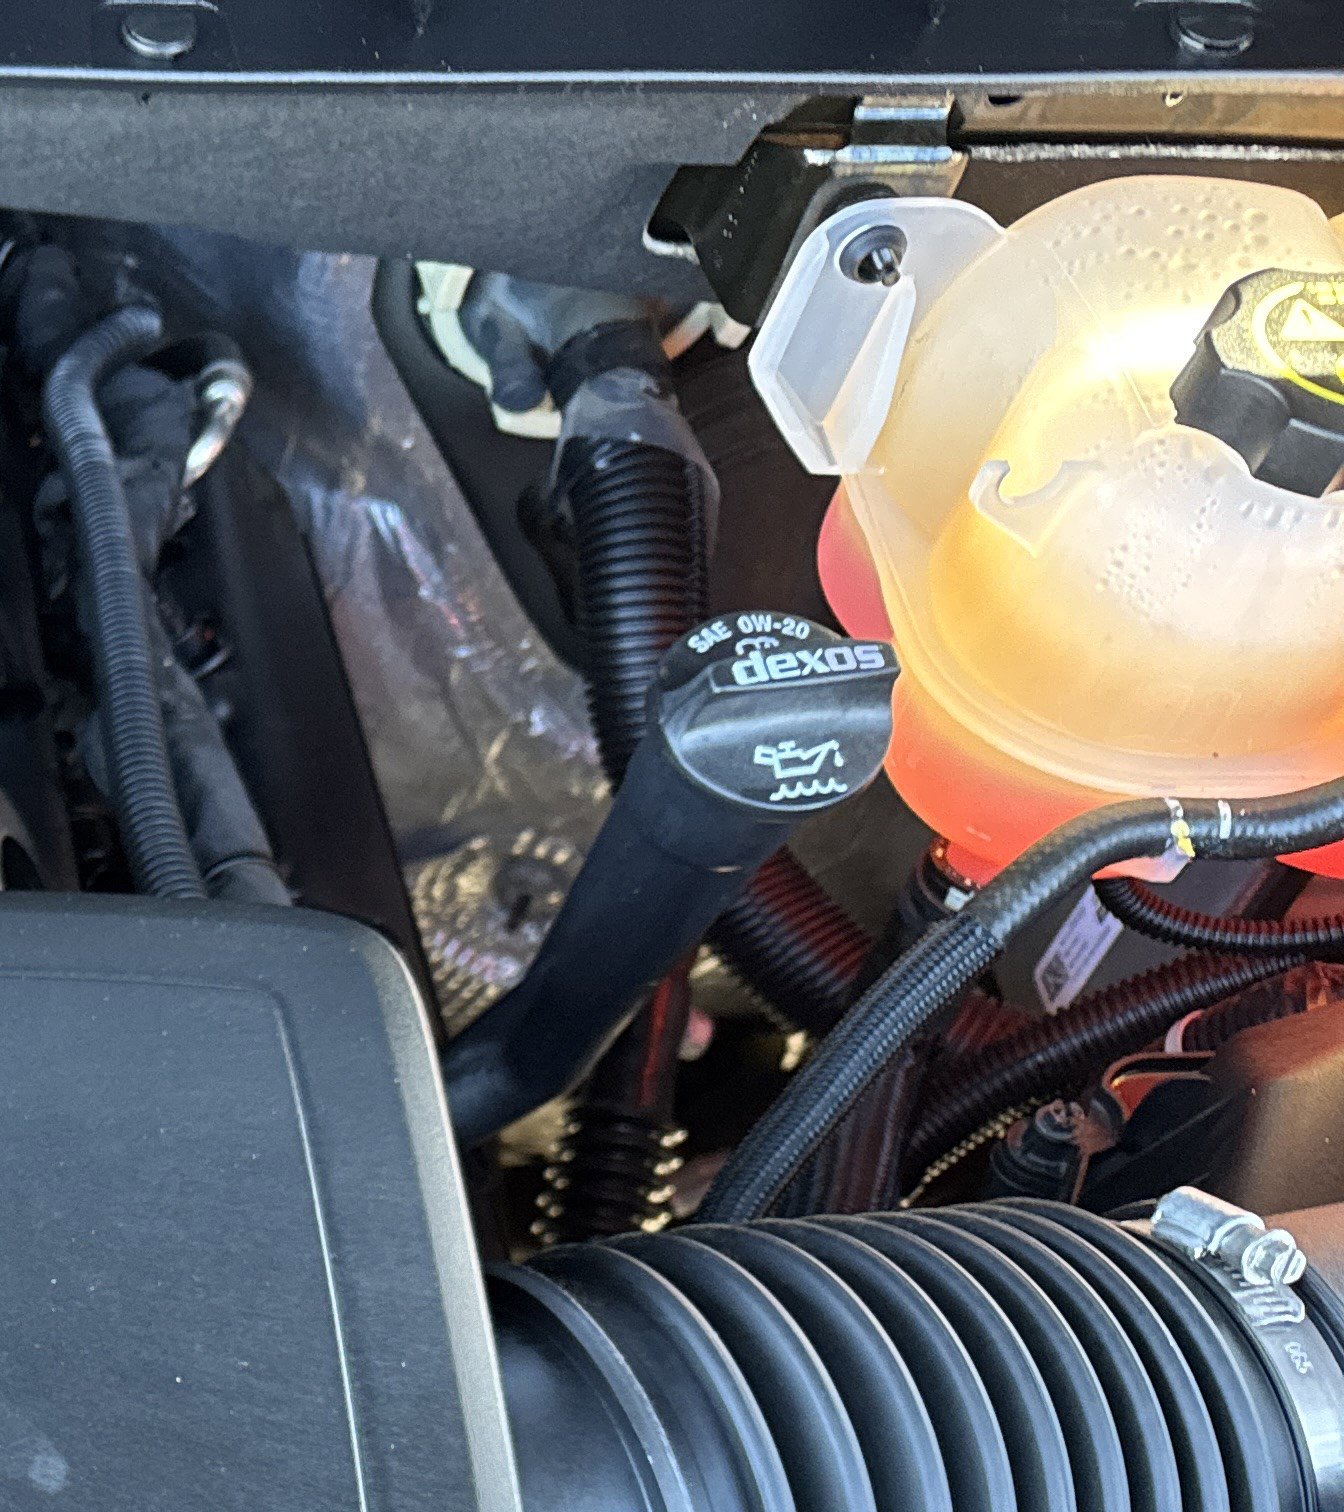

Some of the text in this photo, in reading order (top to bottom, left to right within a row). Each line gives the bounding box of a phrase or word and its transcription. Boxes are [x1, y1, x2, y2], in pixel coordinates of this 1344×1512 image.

[687, 614, 811, 653] SAE 0W-20
[731, 644, 886, 686] dexos
